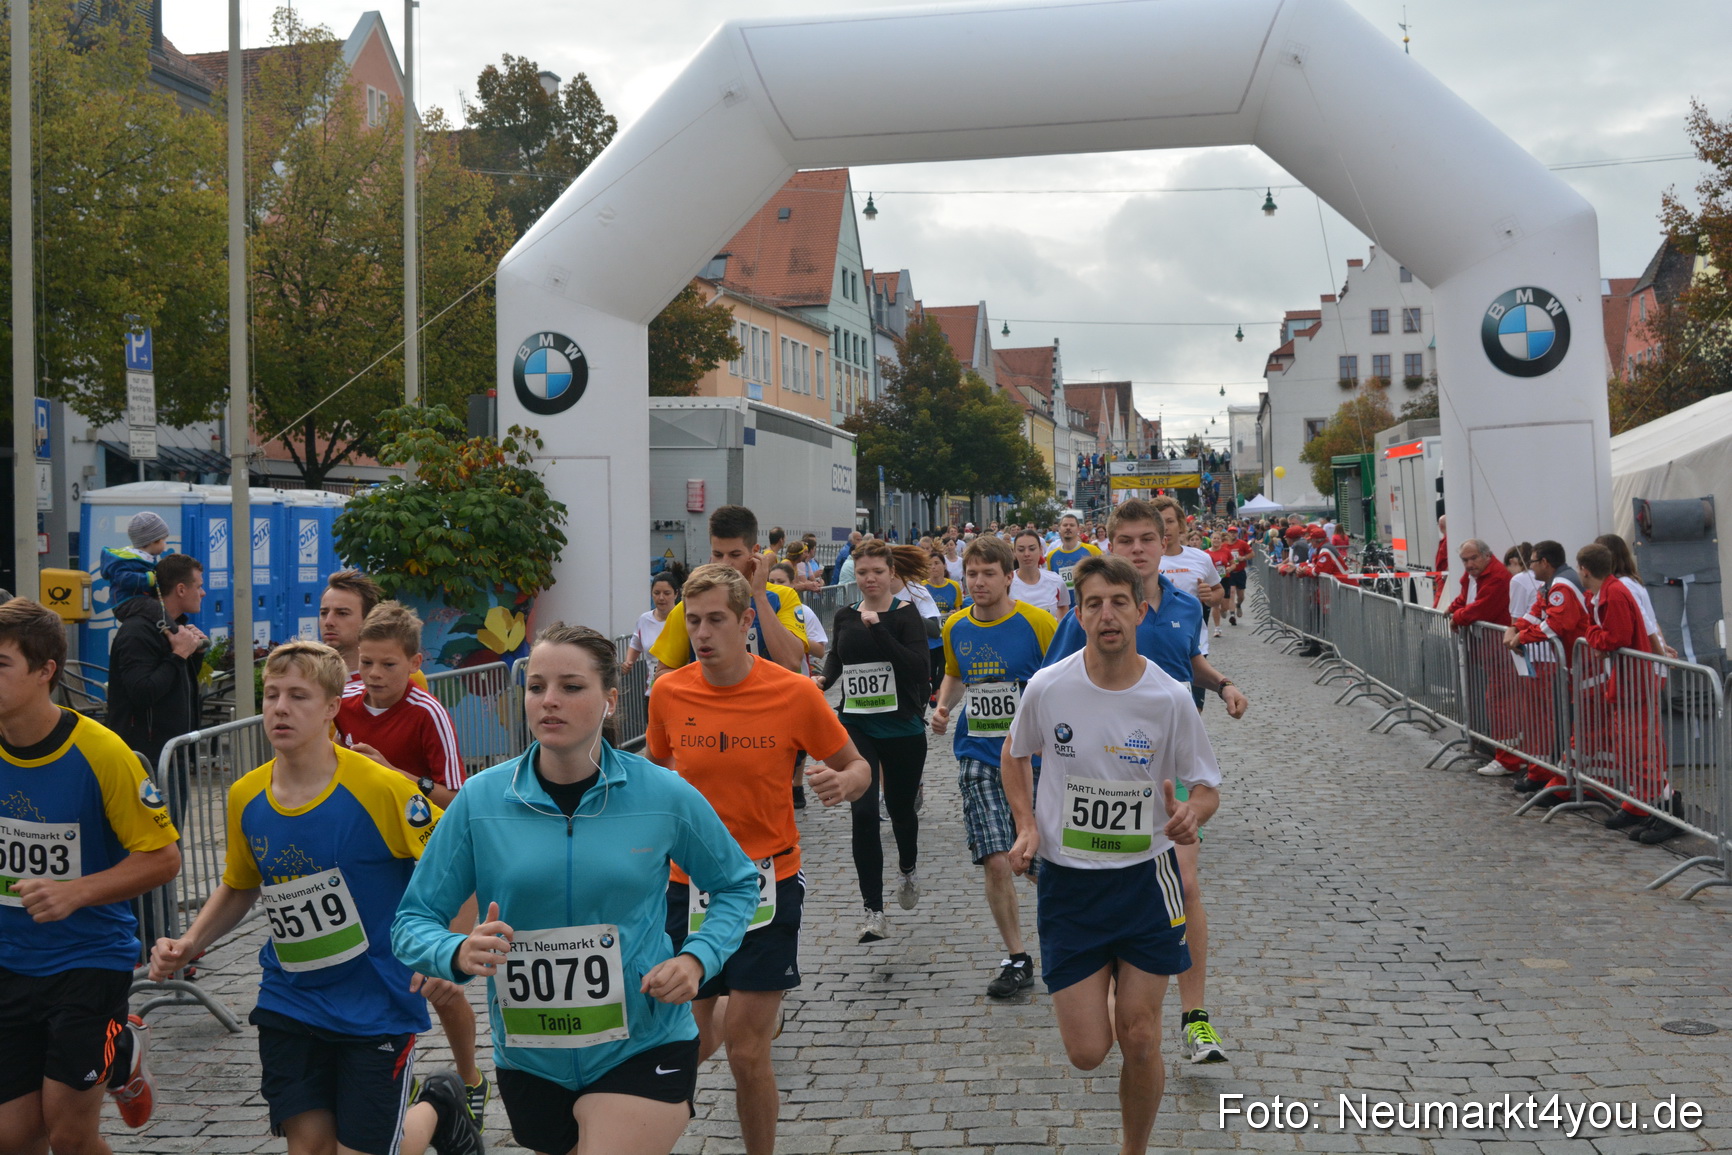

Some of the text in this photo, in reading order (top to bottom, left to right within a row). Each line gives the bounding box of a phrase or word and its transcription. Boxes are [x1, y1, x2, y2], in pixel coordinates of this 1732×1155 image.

[1488, 289, 1563, 320] BMW
[518, 334, 581, 361] BMW
[72, 482, 79, 501] 3
[1140, 477, 1170, 486] START
[209, 523, 227, 549] DIXI
[253, 522, 269, 547] DIXI
[300, 524, 318, 547] DIXI
[1062, 572, 1073, 581] 50
[849, 674, 889, 695] 5087
[856, 699, 886, 707] Michaela
[971, 695, 1016, 717] 5086
[680, 735, 776, 749] EURO POLES
[1067, 783, 1141, 797] PARTL Neumarkt
[1072, 797, 1143, 830] 5021
[14, 829, 60, 840] Neumarkt
[1092, 837, 1122, 850] Hans
[277, 883, 326, 902] Neumarkt
[267, 893, 347, 939] 5519
[534, 938, 595, 953] Neumarkt
[506, 955, 610, 1003] 5079
[538, 1013, 582, 1034] Tanja
